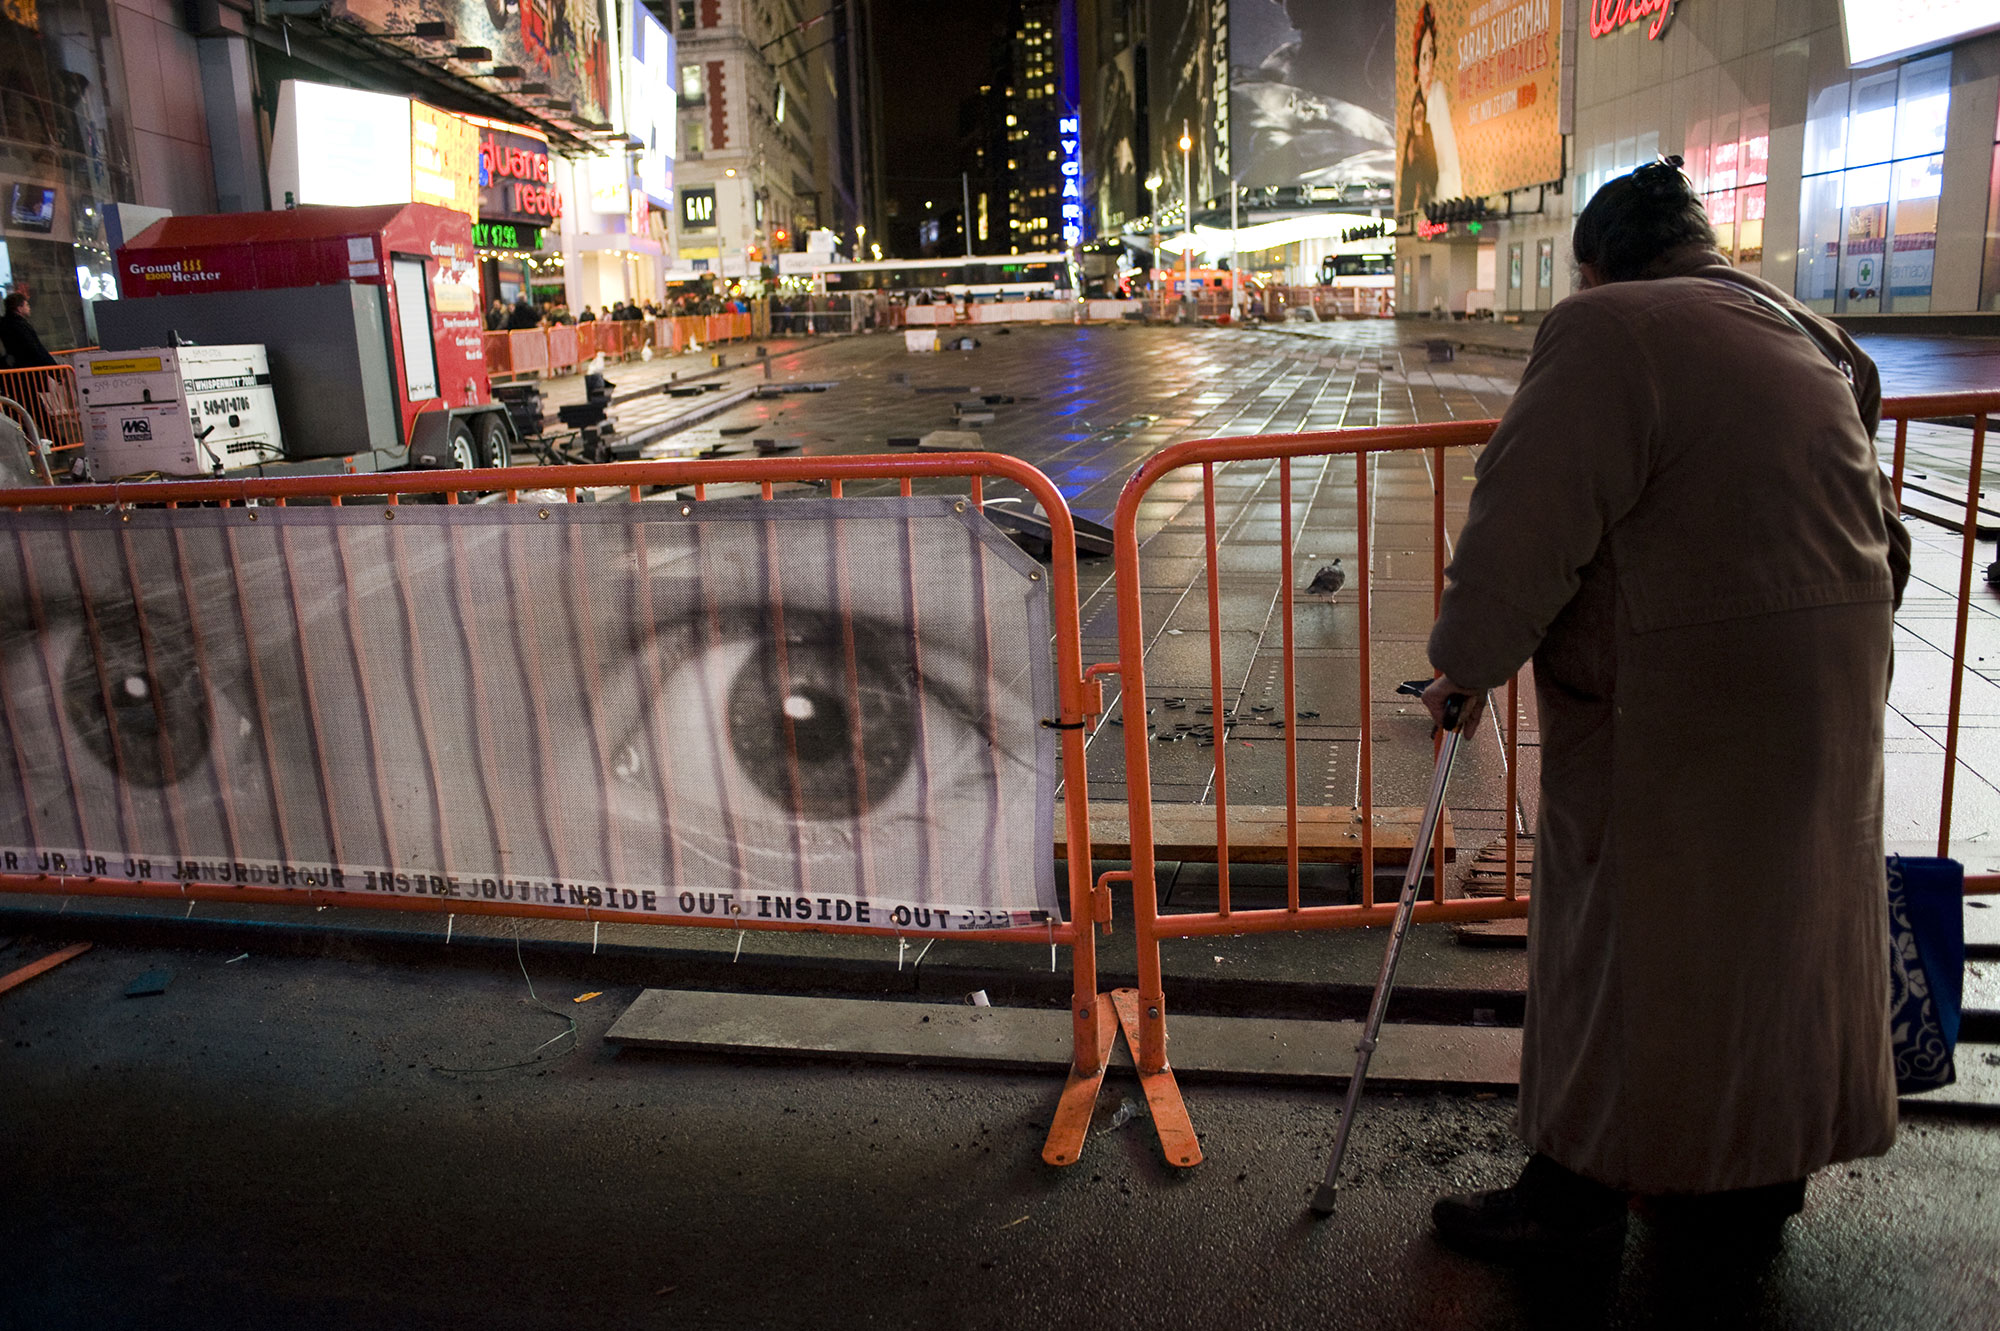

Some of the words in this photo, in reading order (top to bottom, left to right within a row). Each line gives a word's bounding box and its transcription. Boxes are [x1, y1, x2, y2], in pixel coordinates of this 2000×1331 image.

[1458, 23, 1488, 70] SARAH
[1491, 0, 1550, 54] SILVERMAN
[480, 133, 549, 184] duane
[686, 196, 713, 221] GAP
[129, 261, 182, 275] Ground
[172, 271, 221, 282] Heater
[38, 852, 67, 872] JR
[83, 855, 107, 875] JR
[125, 858, 152, 878] JR
[552, 883, 657, 911] INSIDE
[679, 891, 735, 915] OUT
[757, 895, 871, 923] INSIDE
[895, 904, 951, 929] OUT
